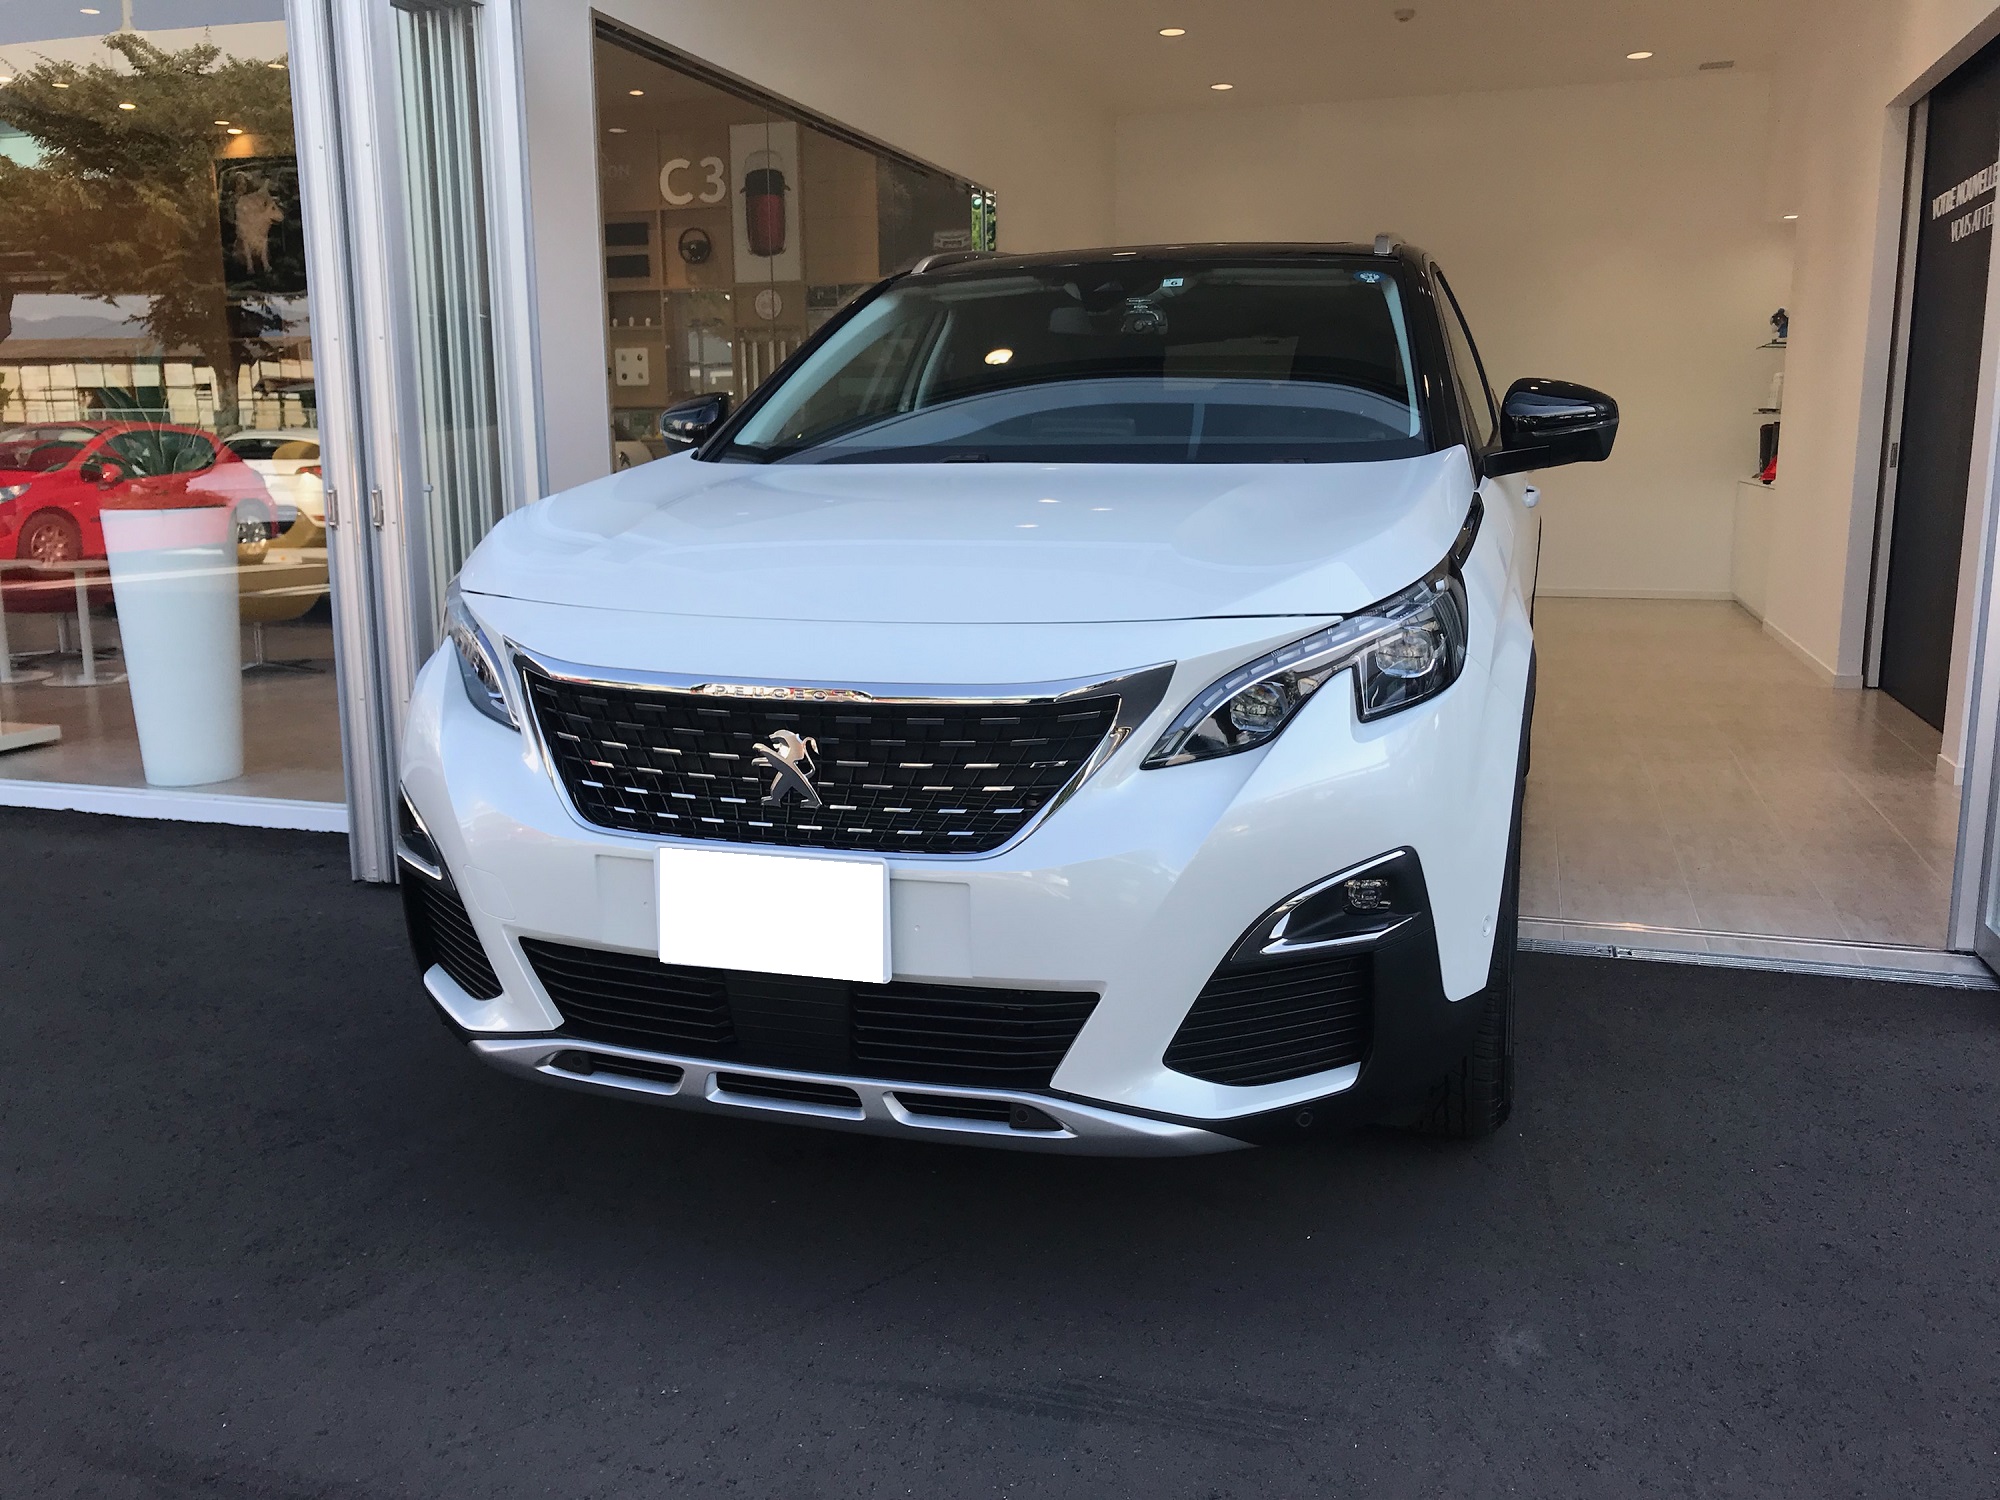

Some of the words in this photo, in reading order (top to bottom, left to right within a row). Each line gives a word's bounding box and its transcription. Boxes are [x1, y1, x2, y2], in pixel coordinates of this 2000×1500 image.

[659, 156, 726, 206] C3
[1951, 212, 1972, 243] VOUS
[714, 684, 849, 702] PEUGEOT
